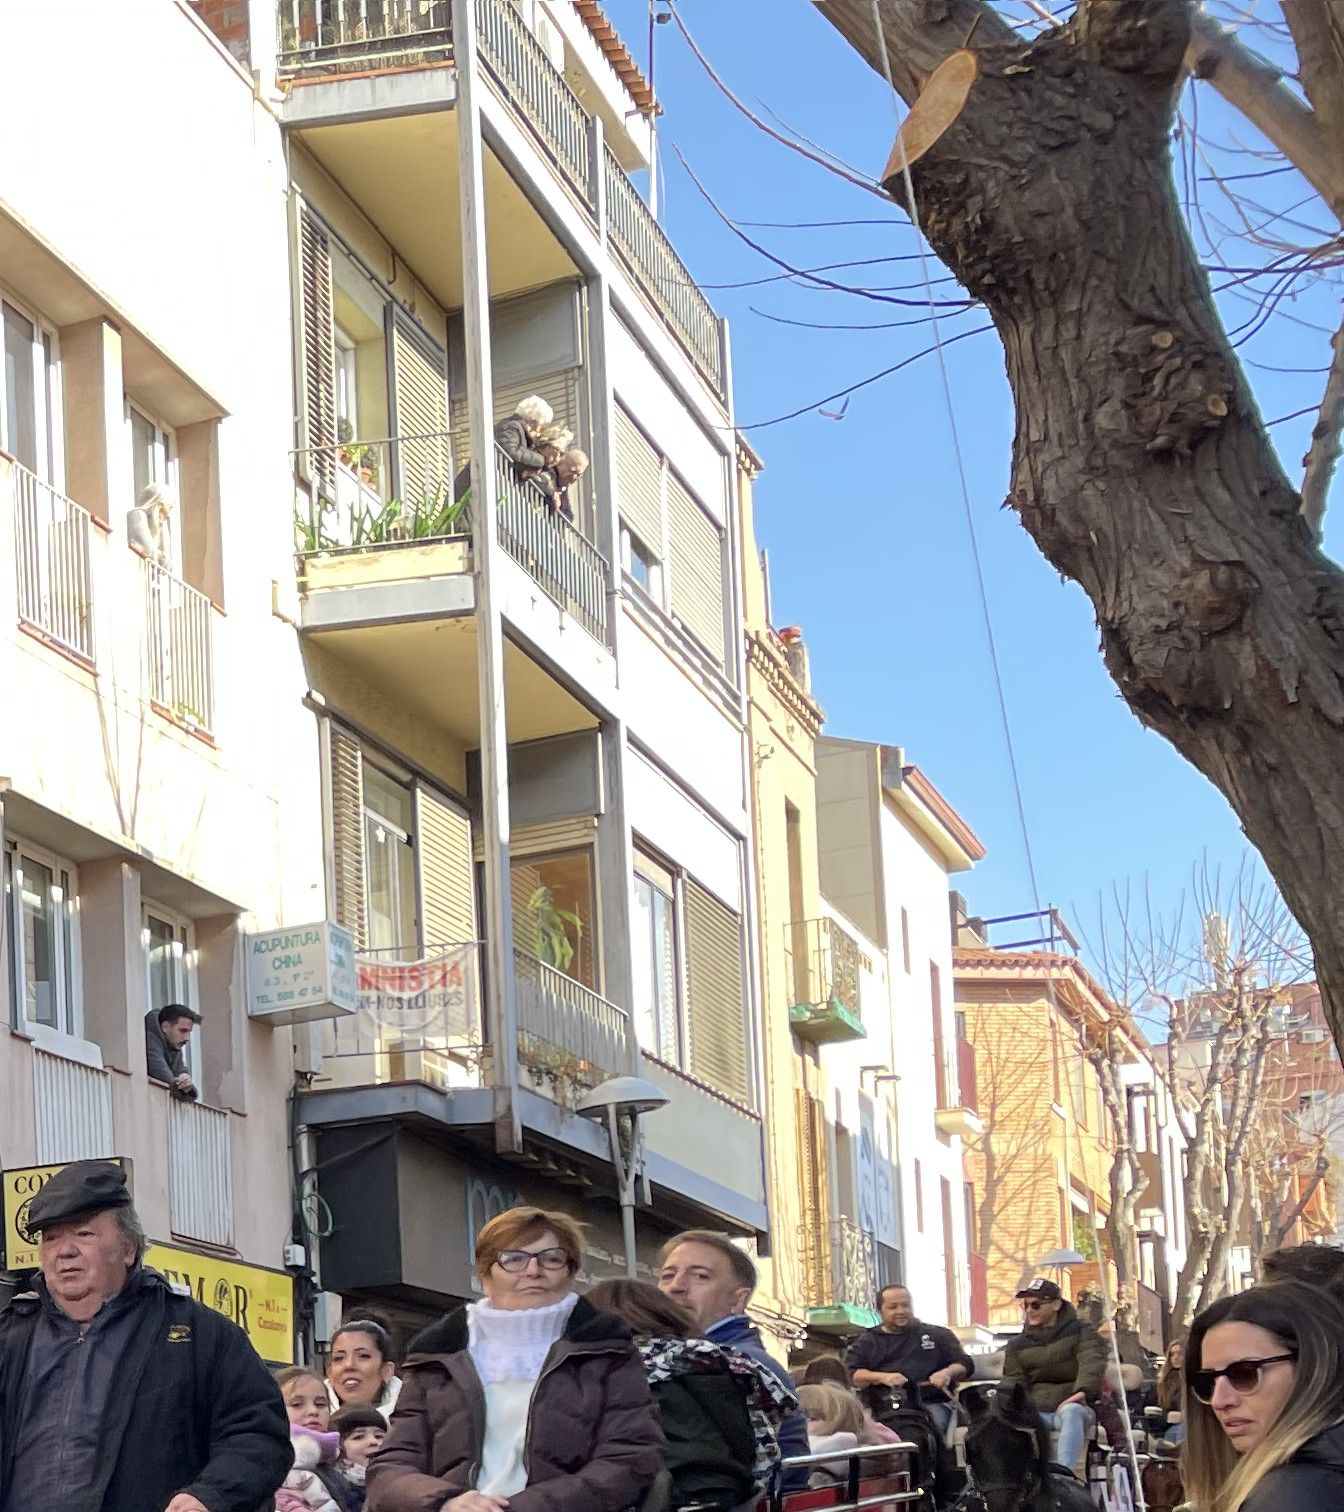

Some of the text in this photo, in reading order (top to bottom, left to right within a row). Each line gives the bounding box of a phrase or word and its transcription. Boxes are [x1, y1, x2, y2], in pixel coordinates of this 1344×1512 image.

[253, 930, 321, 955] ACUPUNTURA
[272, 952, 303, 970] CHINA
[359, 960, 462, 992] MNISTIA
